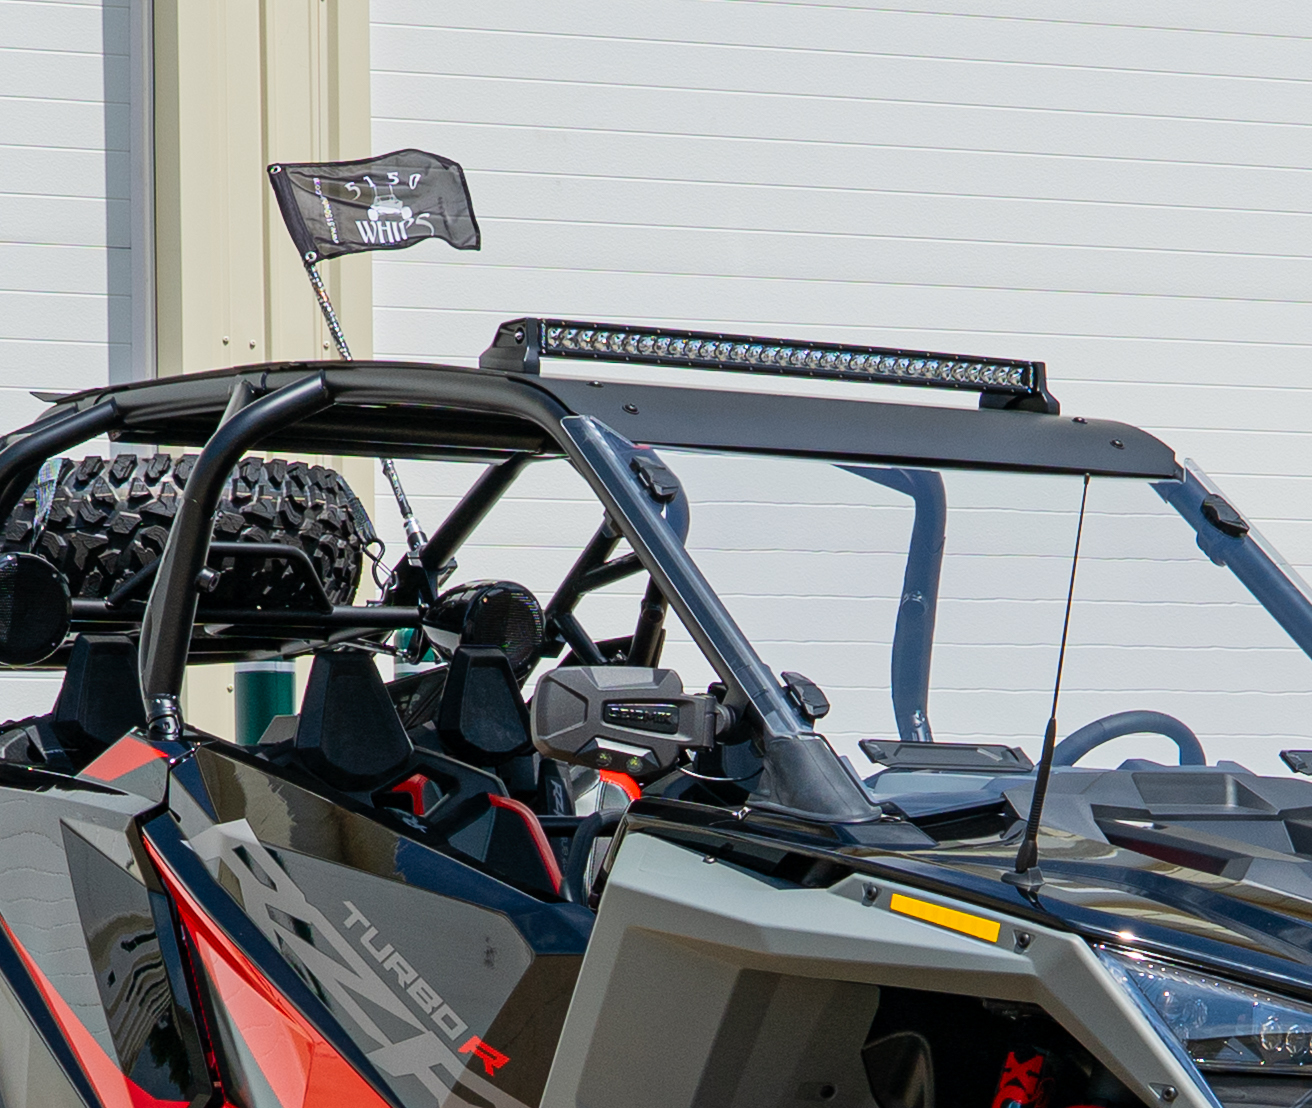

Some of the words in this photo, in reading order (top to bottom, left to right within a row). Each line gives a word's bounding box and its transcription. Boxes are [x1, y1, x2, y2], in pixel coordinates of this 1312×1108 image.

[344, 171, 422, 202] 5150
[355, 212, 436, 245] WHIPS
[549, 778, 566, 817] RZ
[340, 900, 470, 1042] TURBO
[456, 1034, 512, 1078] R
